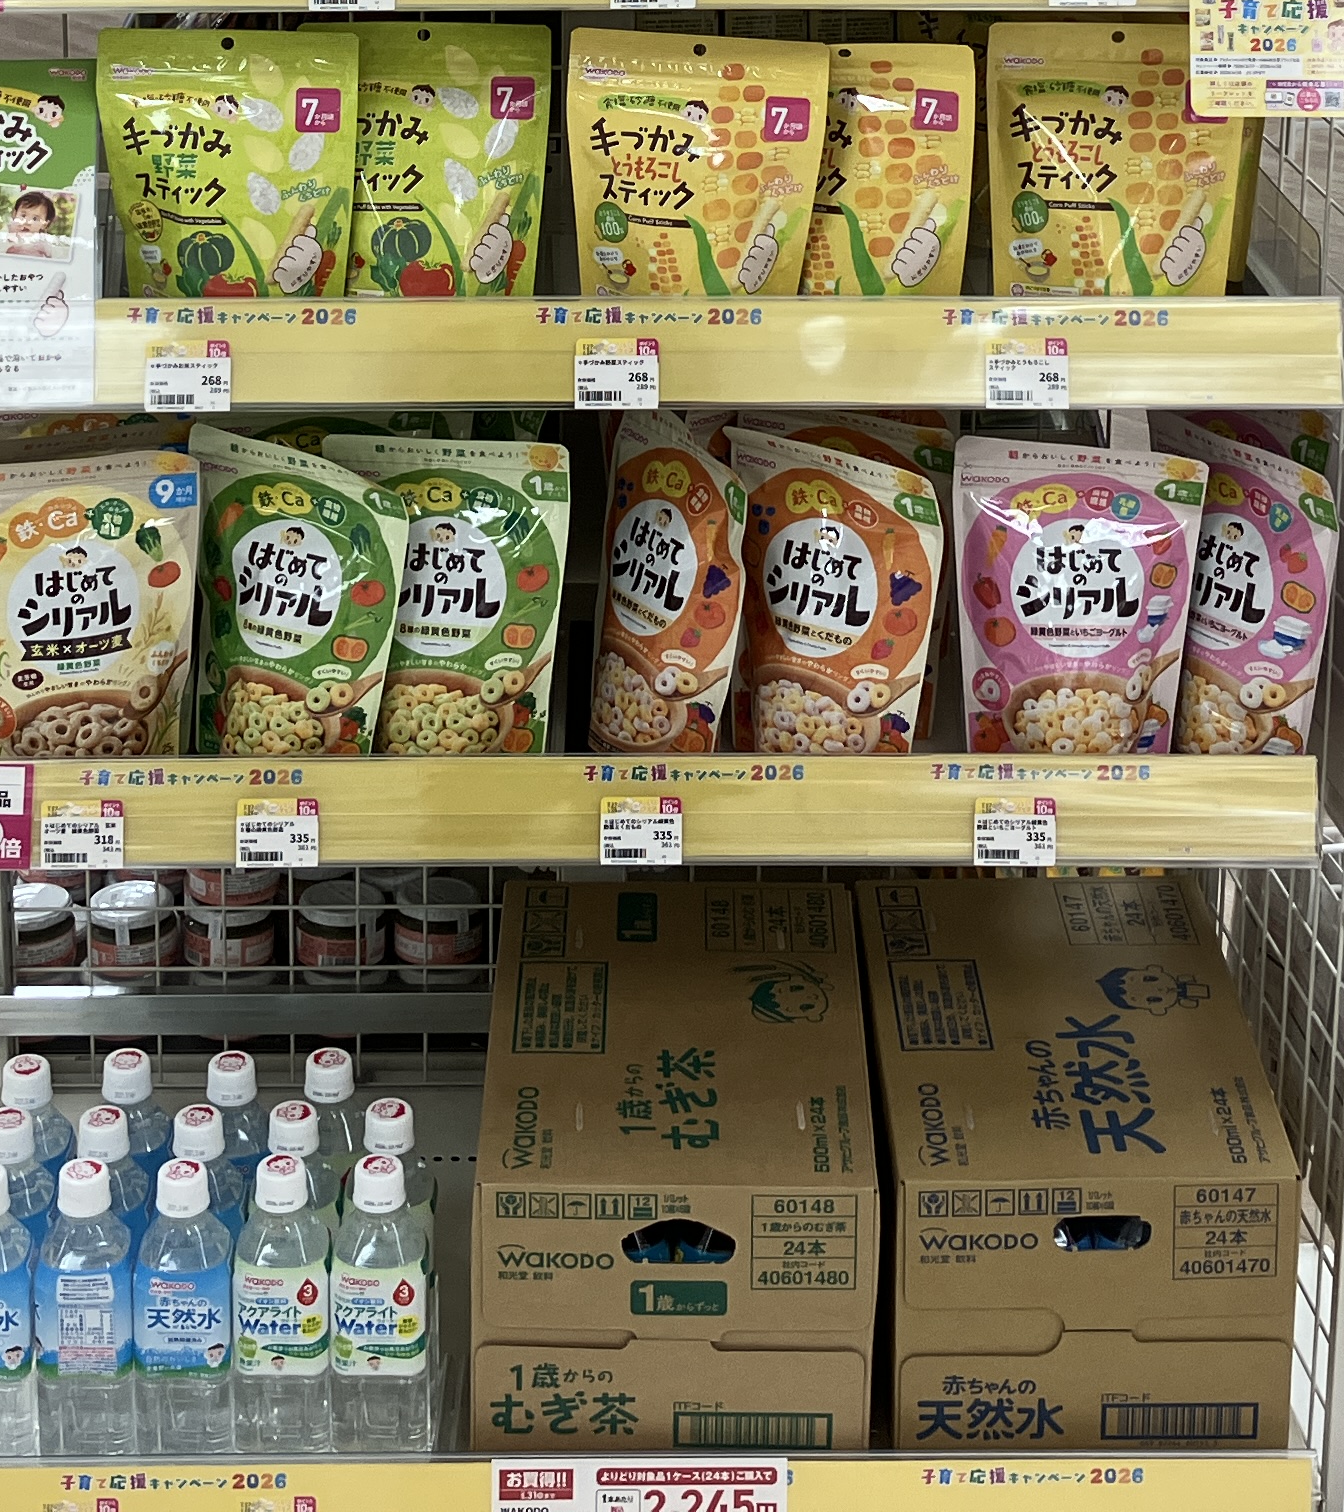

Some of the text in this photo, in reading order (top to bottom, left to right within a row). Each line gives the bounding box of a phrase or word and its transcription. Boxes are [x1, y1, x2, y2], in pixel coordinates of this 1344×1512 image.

[1237, 23, 1310, 35] キャンペーン
[1249, 37, 1297, 52] 2026
[611, 156, 682, 182] とうもろこし
[247, 542, 328, 581] はじめて
[434, 571, 449, 584] の
[17, 589, 132, 637] シリアル
[29, 636, 125, 658] 玄米×オーツ麦
[1056, 1014, 1166, 1155] 天然水
[1196, 1188, 1256, 1203] 60147
[773, 1199, 835, 1214] 60148
[1179, 1209, 1272, 1225] 赤ちゃんの天然水
[1205, 1230, 1247, 1245] 24本
[783, 1240, 826, 1256] 24本
[1179, 1258, 1270, 1275] 40601470
[757, 1270, 849, 1285] 40601480
[238, 1318, 302, 1337] Water
[509, 1362, 613, 1390] 1歳からの
[942, 1375, 1036, 1395] 赤ちゃんの
[489, 1390, 639, 1436] むぎ茶
[916, 1397, 1065, 1441] 天然水
[505, 1471, 567, 1488] お買得!!
